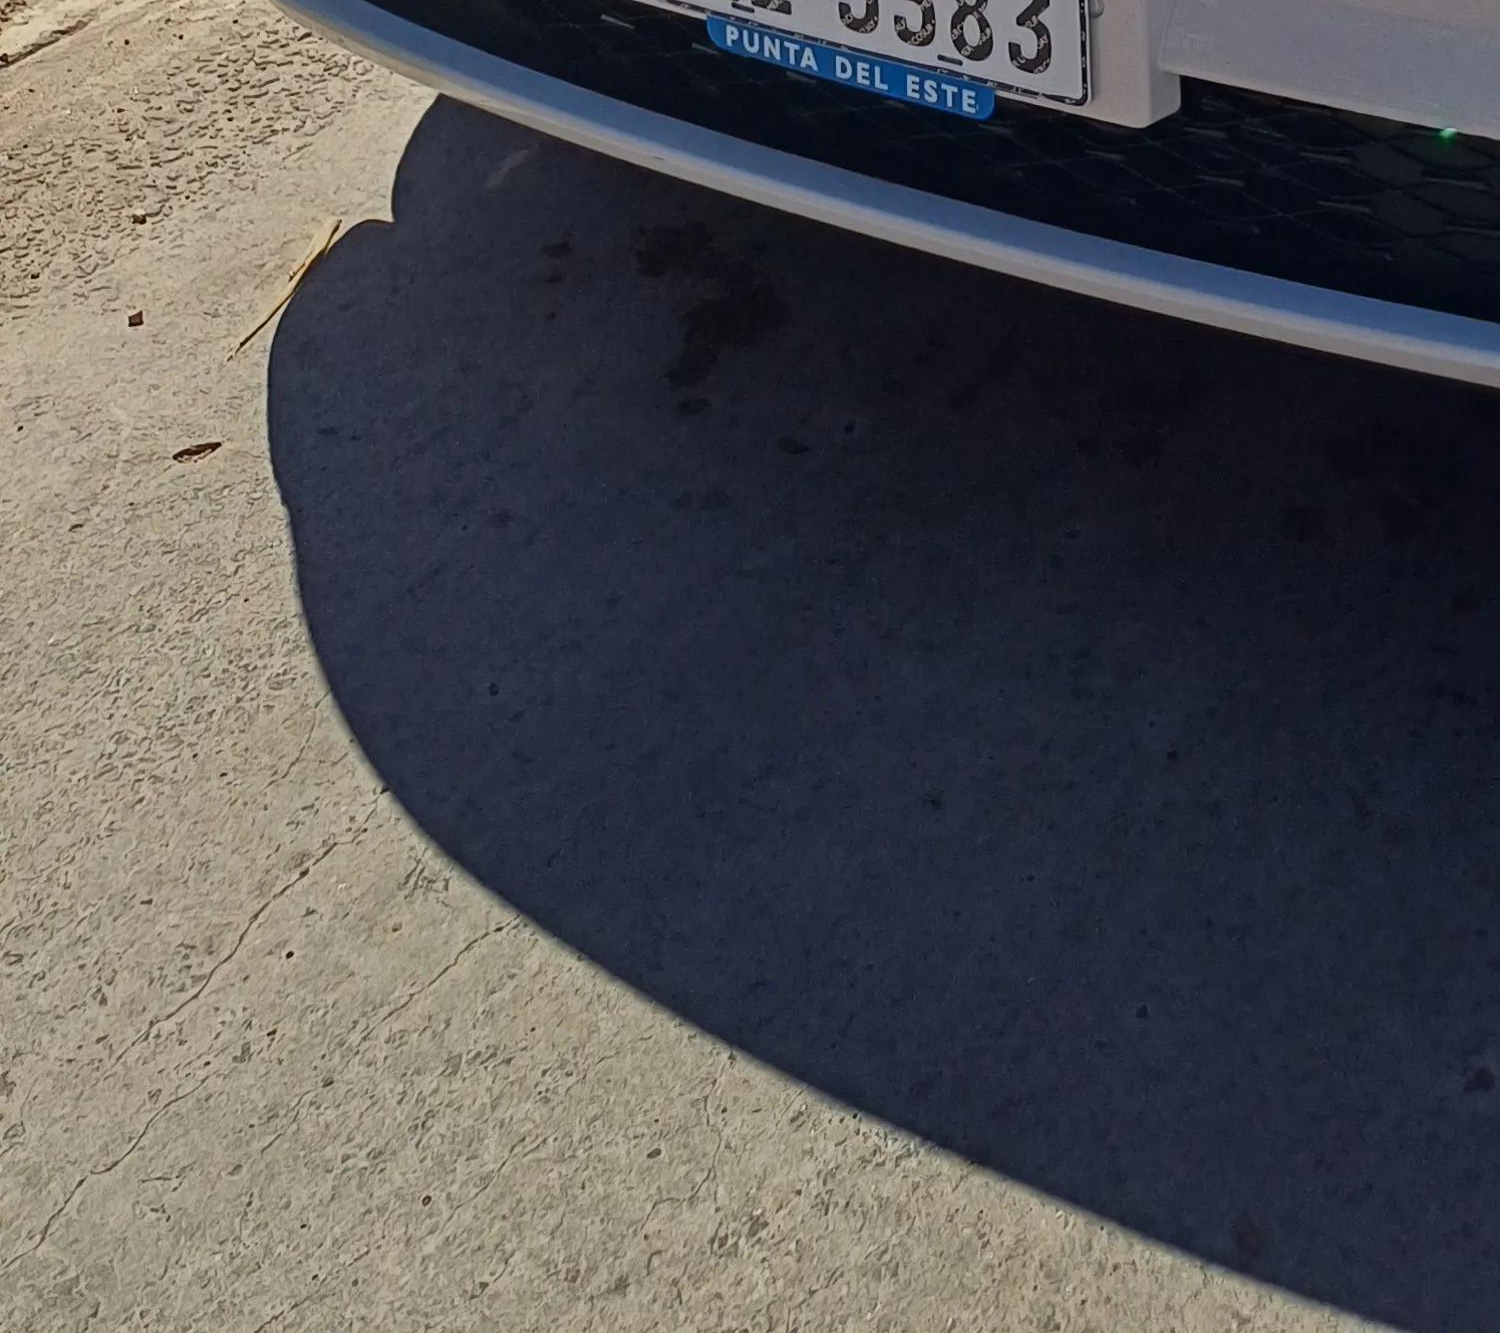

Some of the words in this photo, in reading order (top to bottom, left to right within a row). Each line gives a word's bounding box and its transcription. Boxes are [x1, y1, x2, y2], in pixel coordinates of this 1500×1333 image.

[725, 24, 819, 72] PUNTA
[835, 55, 889, 91] DEL
[906, 74, 978, 114] ESTE
